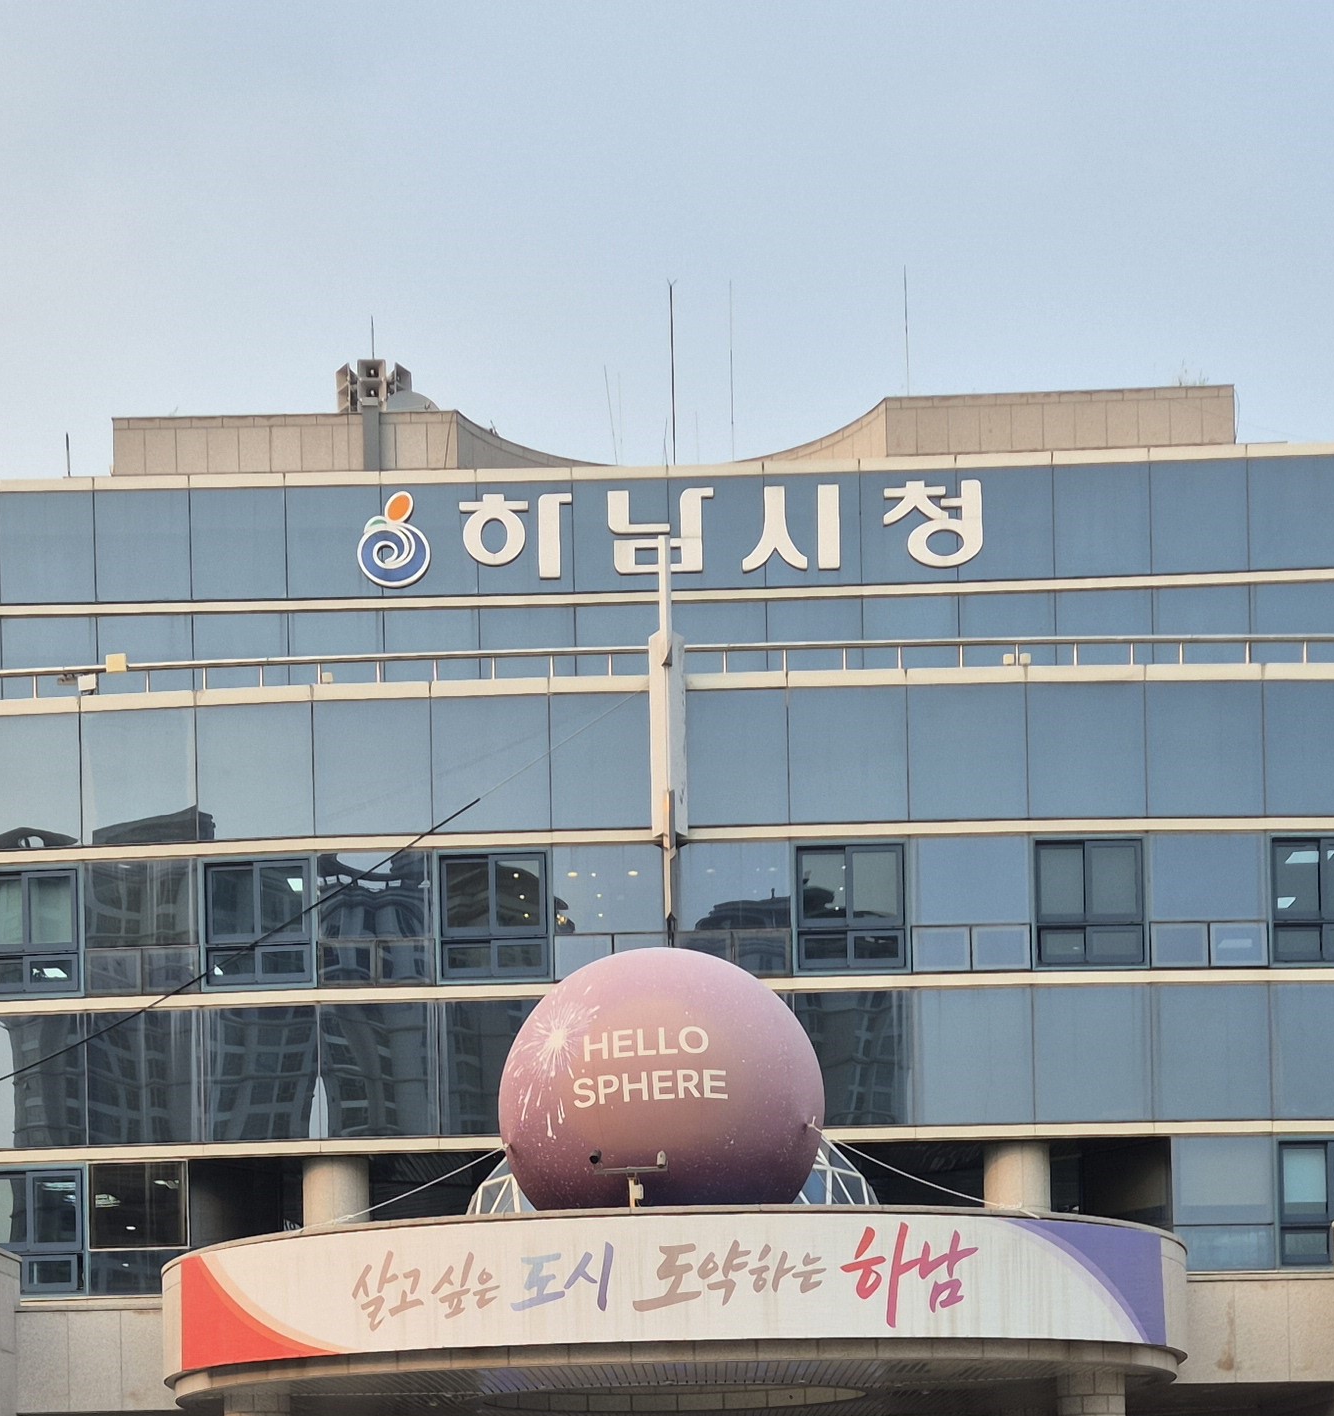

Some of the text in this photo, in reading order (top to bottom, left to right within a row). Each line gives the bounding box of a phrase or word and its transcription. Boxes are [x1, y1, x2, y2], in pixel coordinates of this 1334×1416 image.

[459, 479, 984, 580] 하남시청
[583, 1026, 709, 1062] HELLO
[573, 1069, 729, 1109] SPHERE
[510, 1241, 614, 1312] 도시
[632, 1239, 827, 1313] 도약하는
[839, 1221, 979, 1329] 하남
